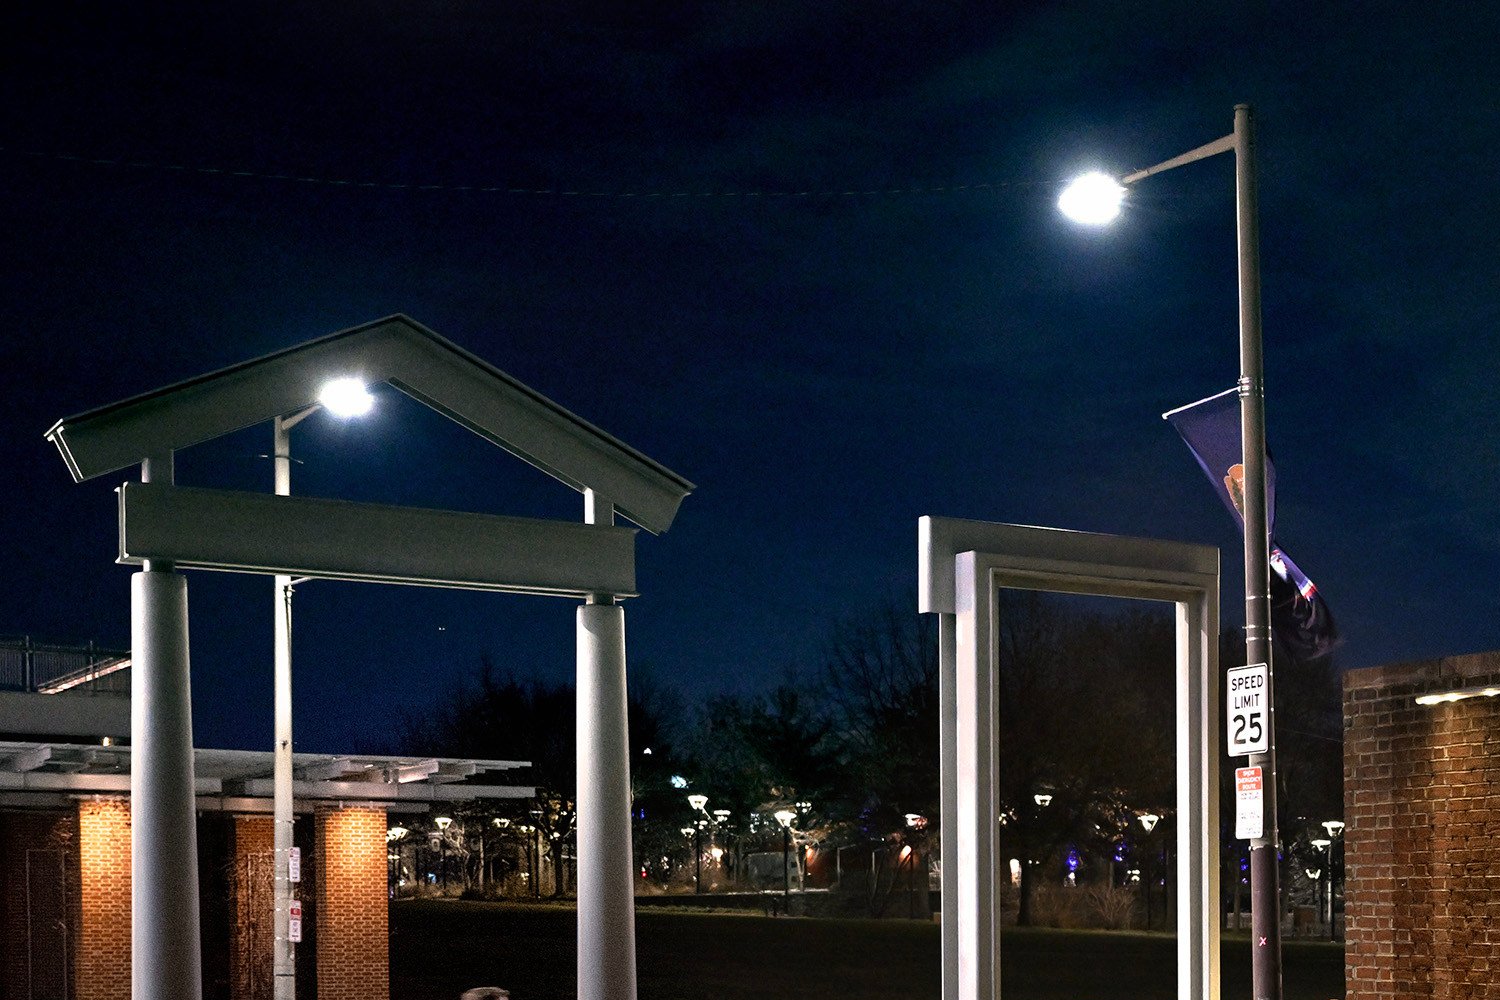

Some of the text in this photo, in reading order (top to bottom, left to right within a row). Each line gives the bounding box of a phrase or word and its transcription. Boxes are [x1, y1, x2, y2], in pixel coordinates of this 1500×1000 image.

[1231, 674, 1263, 691] SPEED
[1234, 694, 1260, 709] LIMIT
[1233, 712, 1262, 745] 25
